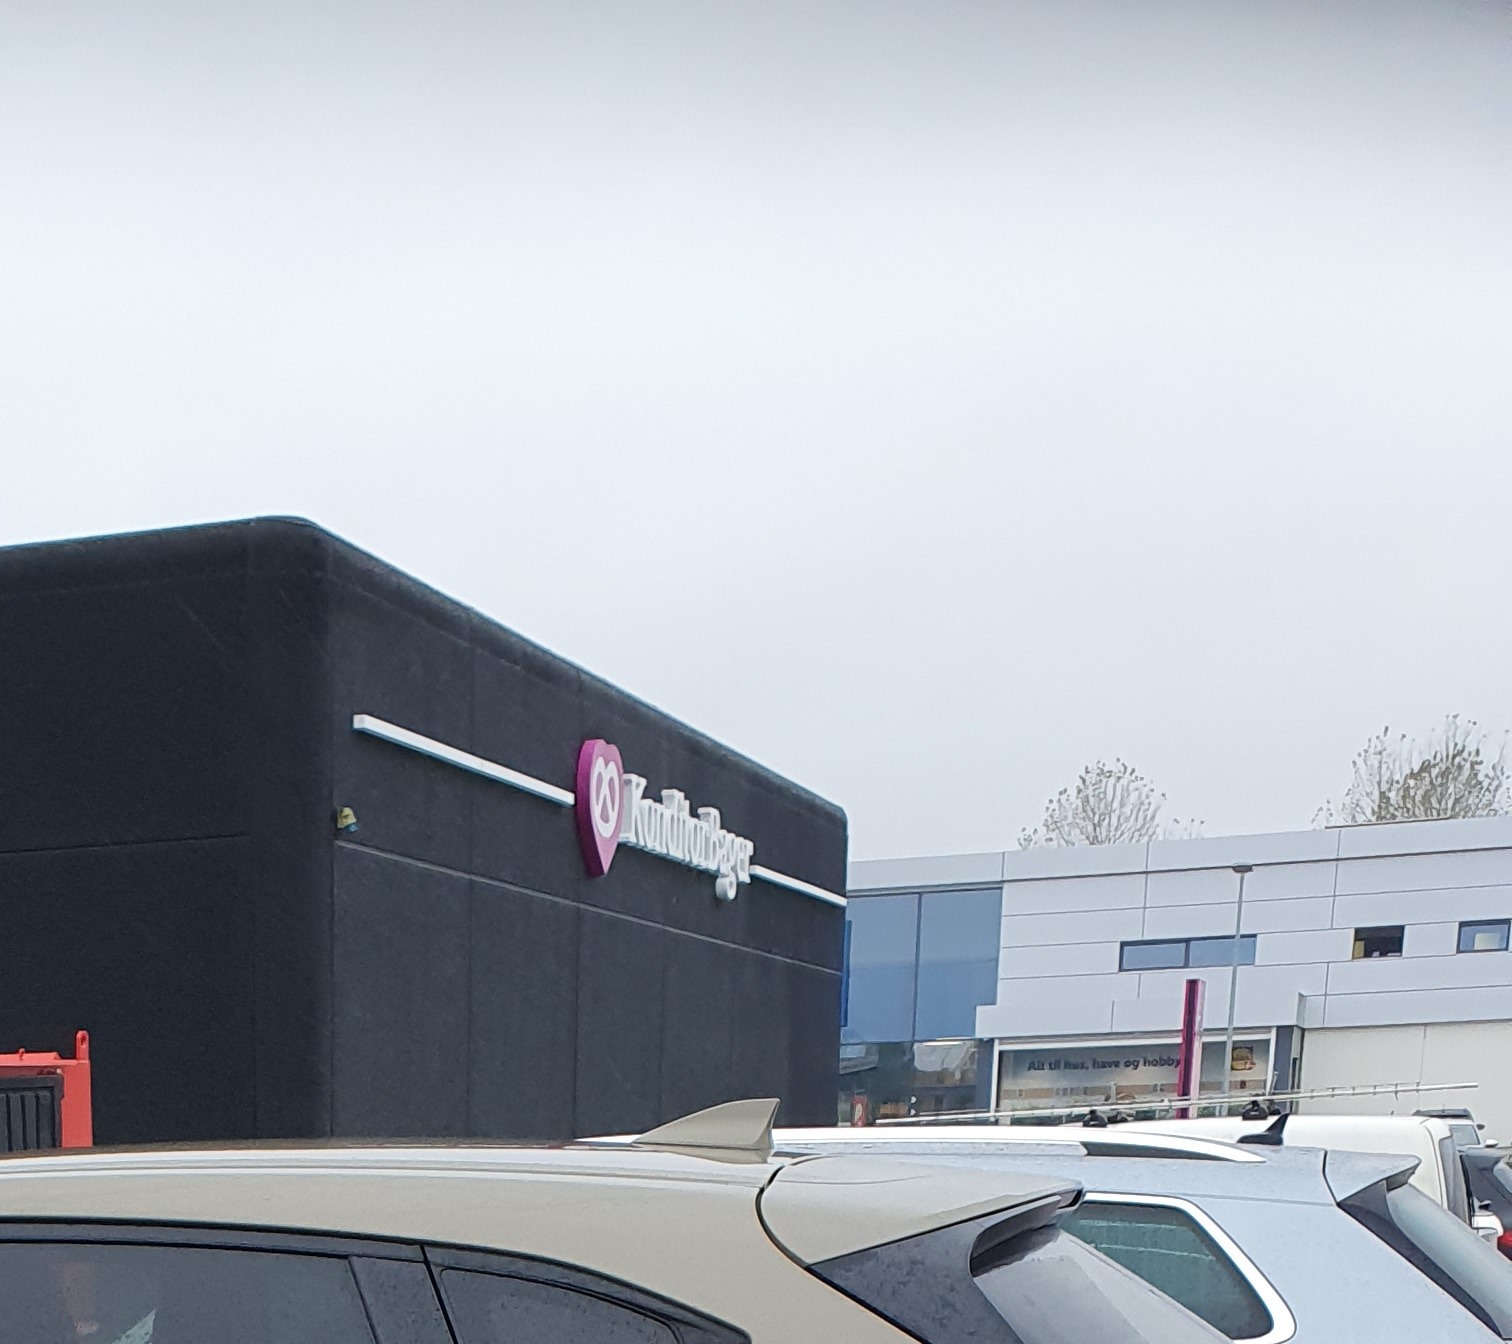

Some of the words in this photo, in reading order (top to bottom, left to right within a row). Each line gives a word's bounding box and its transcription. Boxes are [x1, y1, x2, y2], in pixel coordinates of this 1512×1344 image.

[1048, 1059, 1061, 1071] til
[1092, 1057, 1120, 1069] have
[1124, 1059, 1140, 1070] og
[1143, 1056, 1180, 1068] hobby
